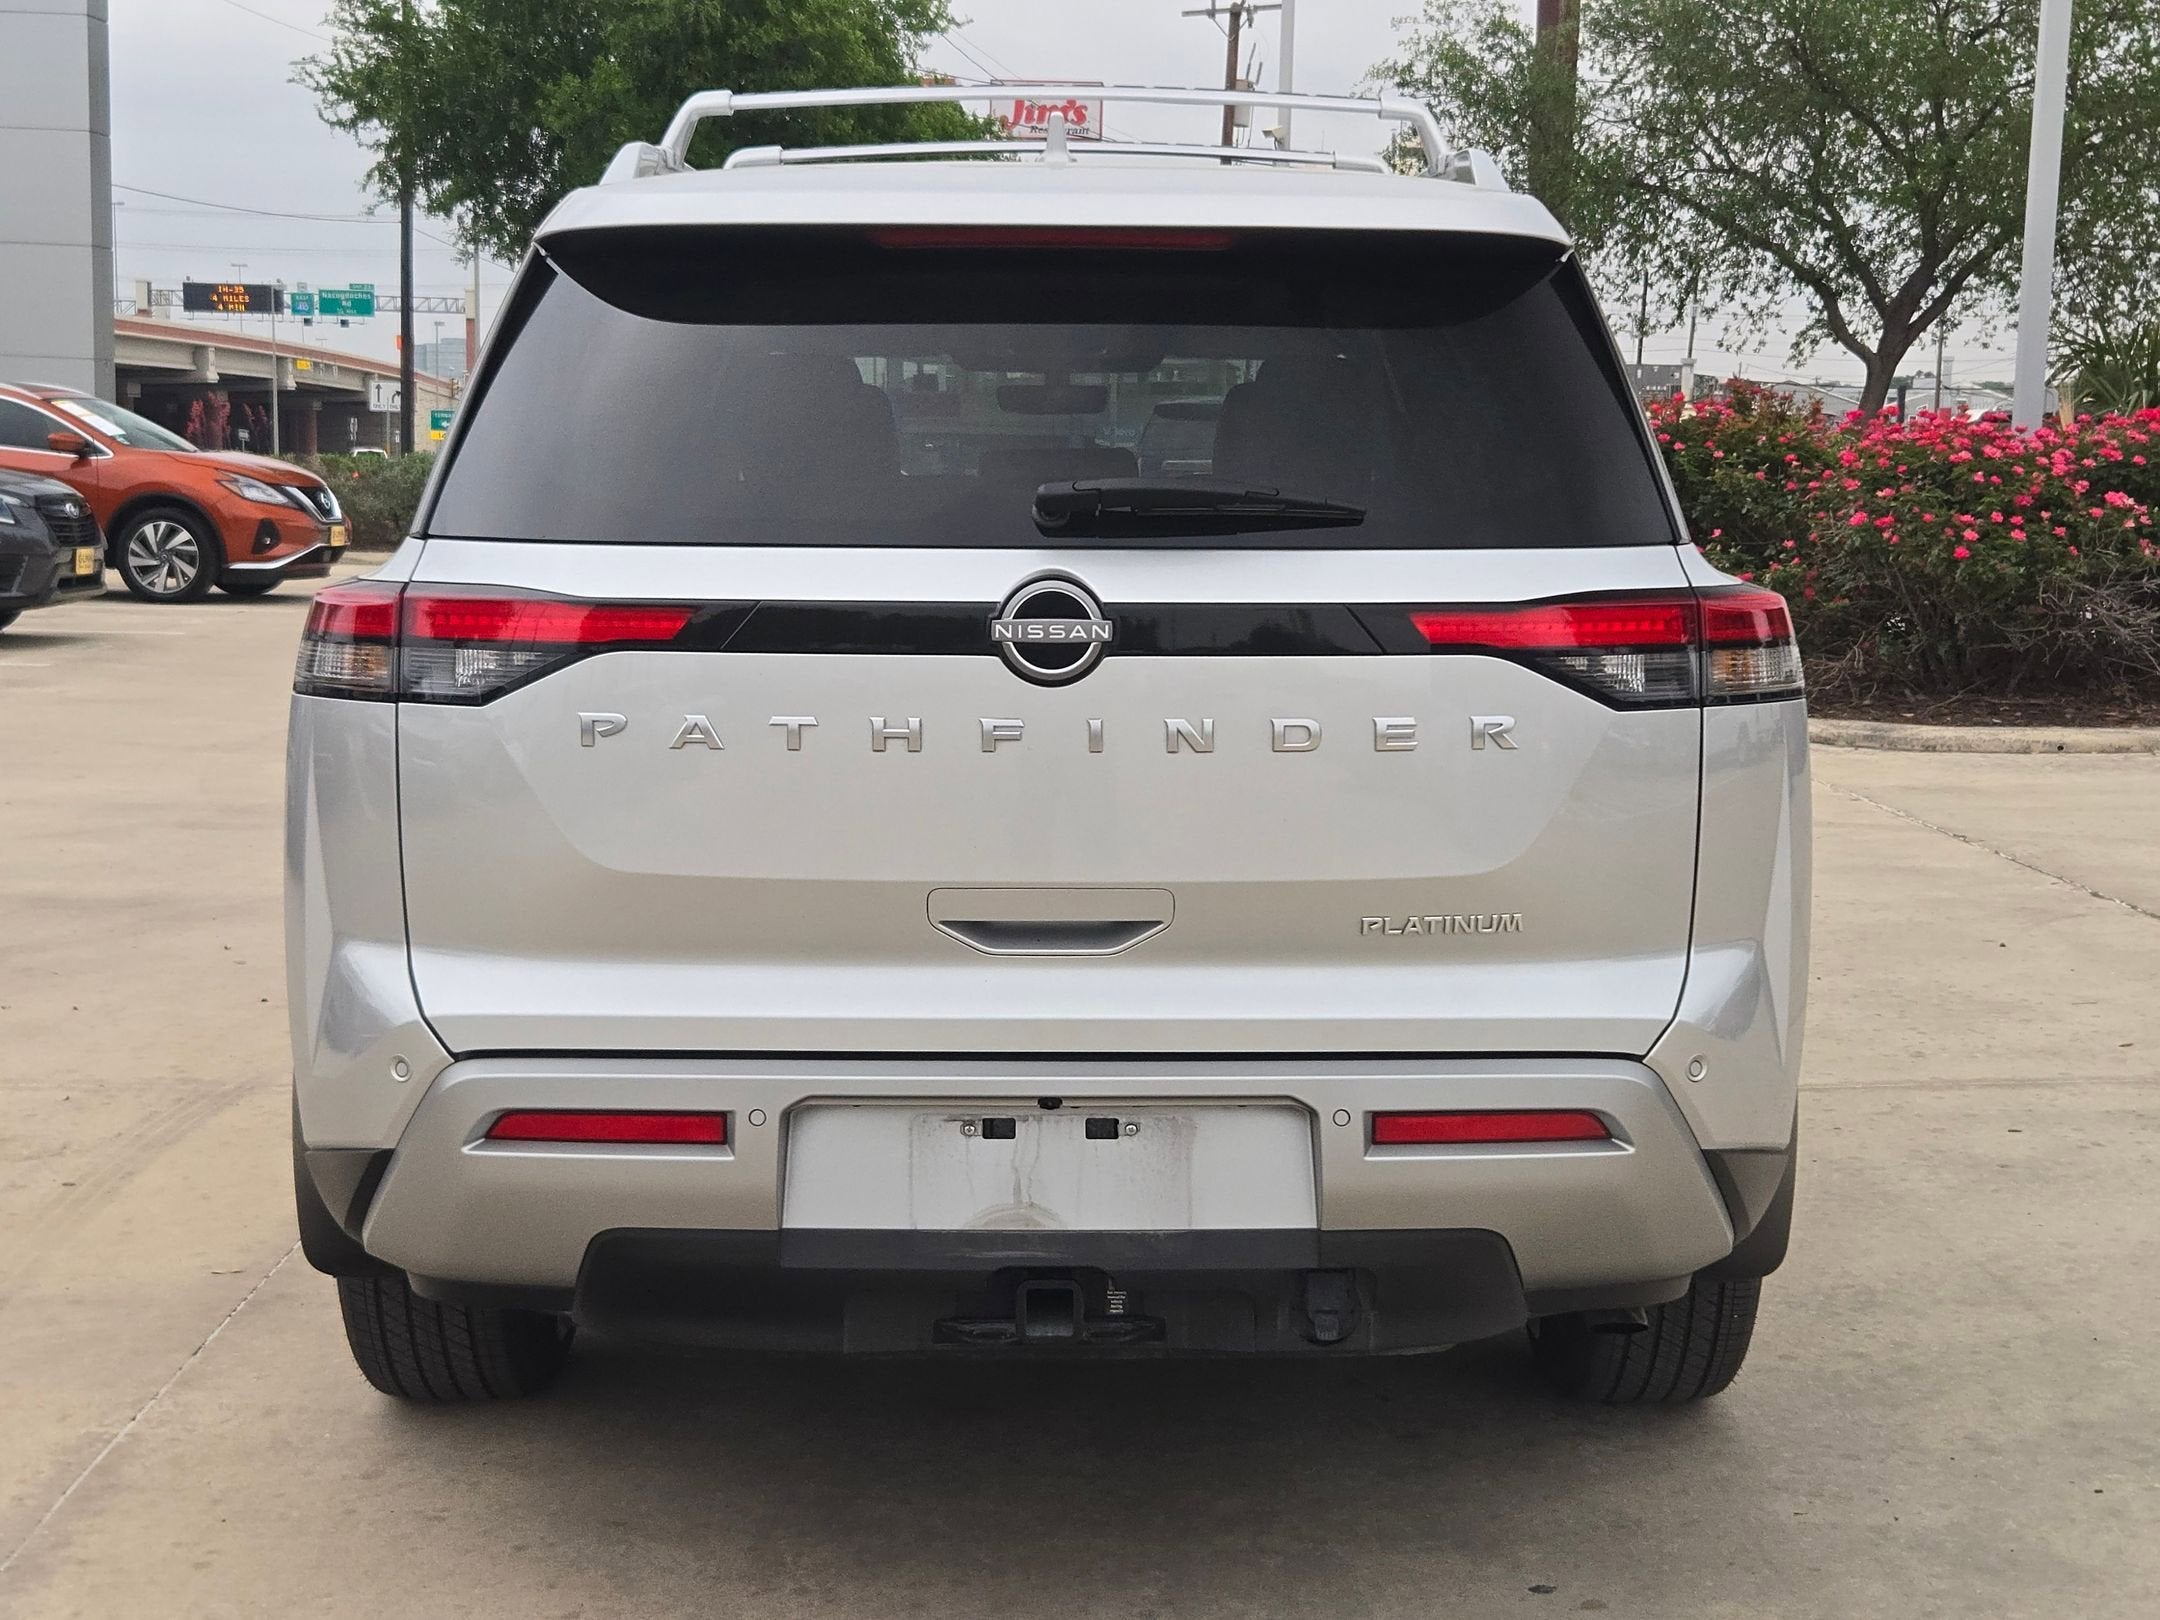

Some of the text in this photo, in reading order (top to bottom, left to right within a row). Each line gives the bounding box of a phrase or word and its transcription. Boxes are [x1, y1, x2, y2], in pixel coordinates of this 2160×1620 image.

[1029, 125, 1090, 135] Resrant
[218, 285, 245, 293] IH-35
[212, 294, 250, 303] 4 MILES
[995, 624, 1109, 639] NISSAN
[577, 711, 1519, 753] PATHFINDER
[1361, 912, 1524, 935] PLATINUM
